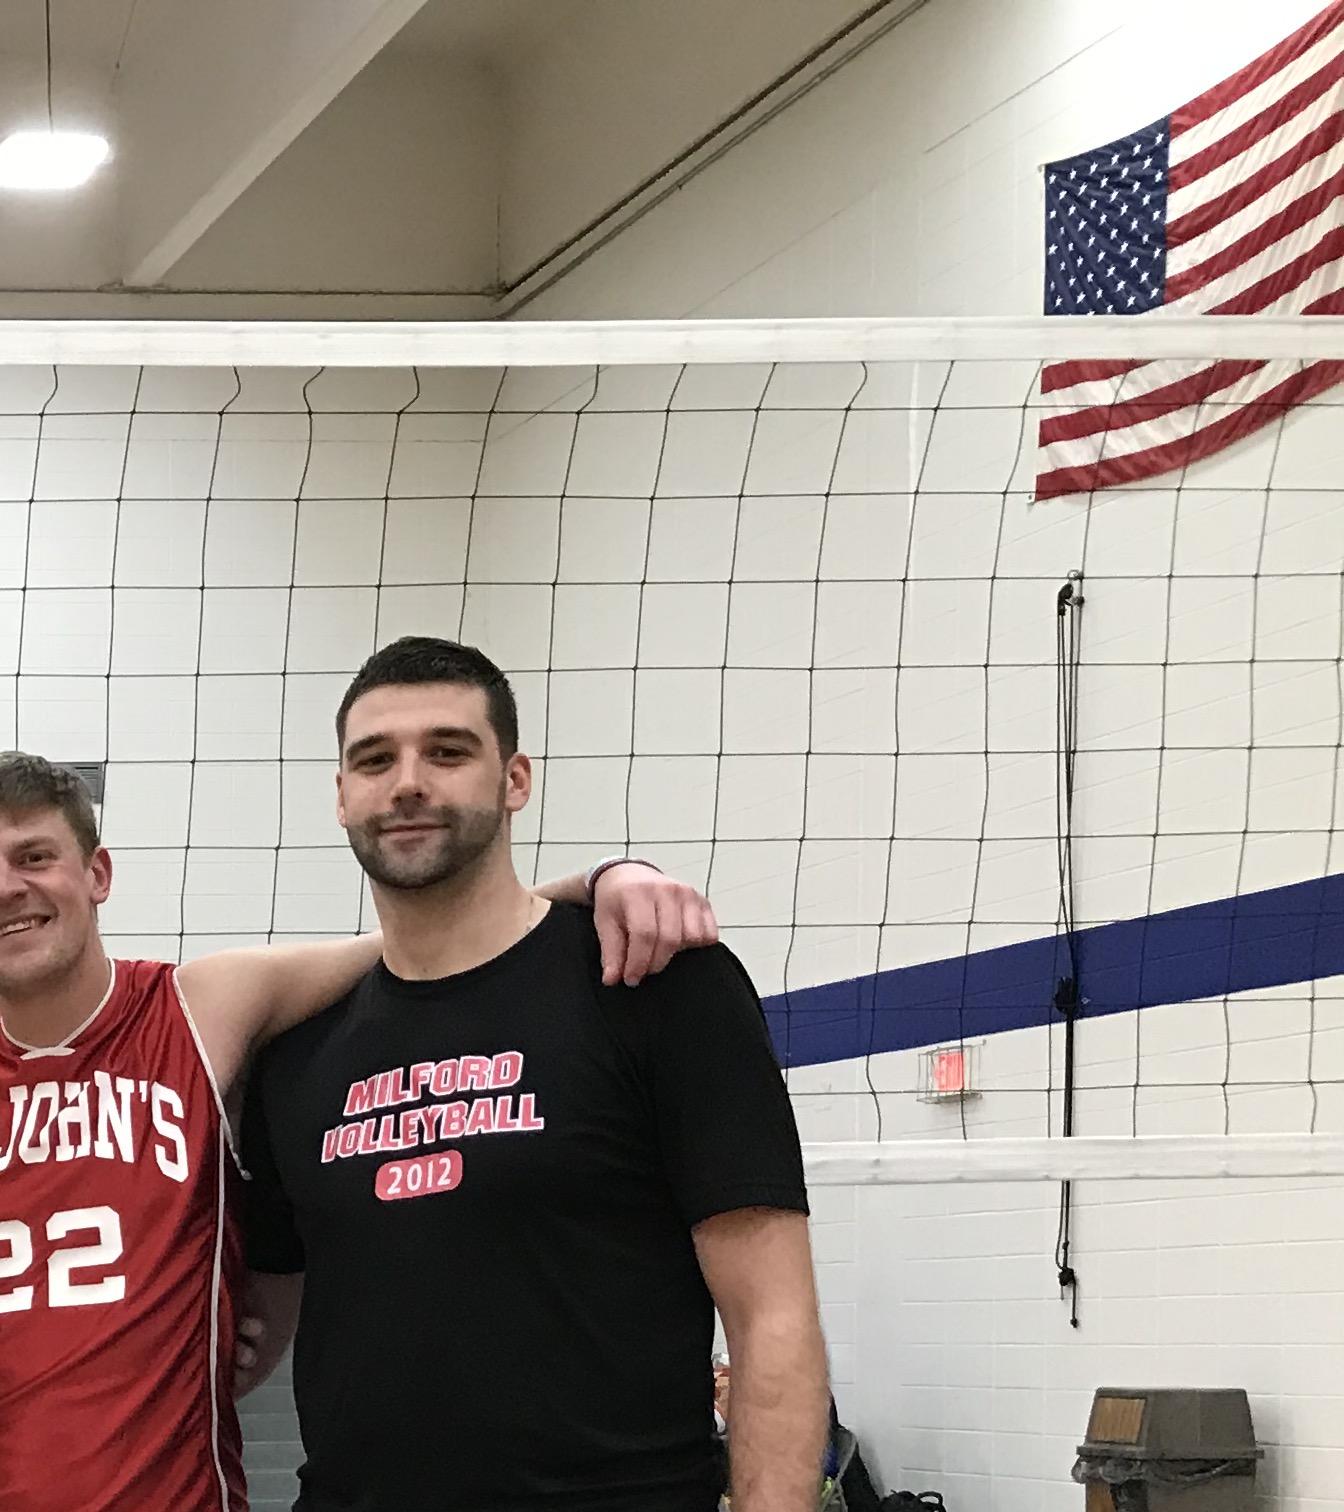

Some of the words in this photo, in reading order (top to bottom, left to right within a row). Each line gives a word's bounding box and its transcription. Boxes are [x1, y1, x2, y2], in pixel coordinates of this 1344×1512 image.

[343, 1051, 524, 1116] MILFORD
[321, 1093, 545, 1163] VOLLEYBALL
[386, 1157, 453, 1195] 2012
